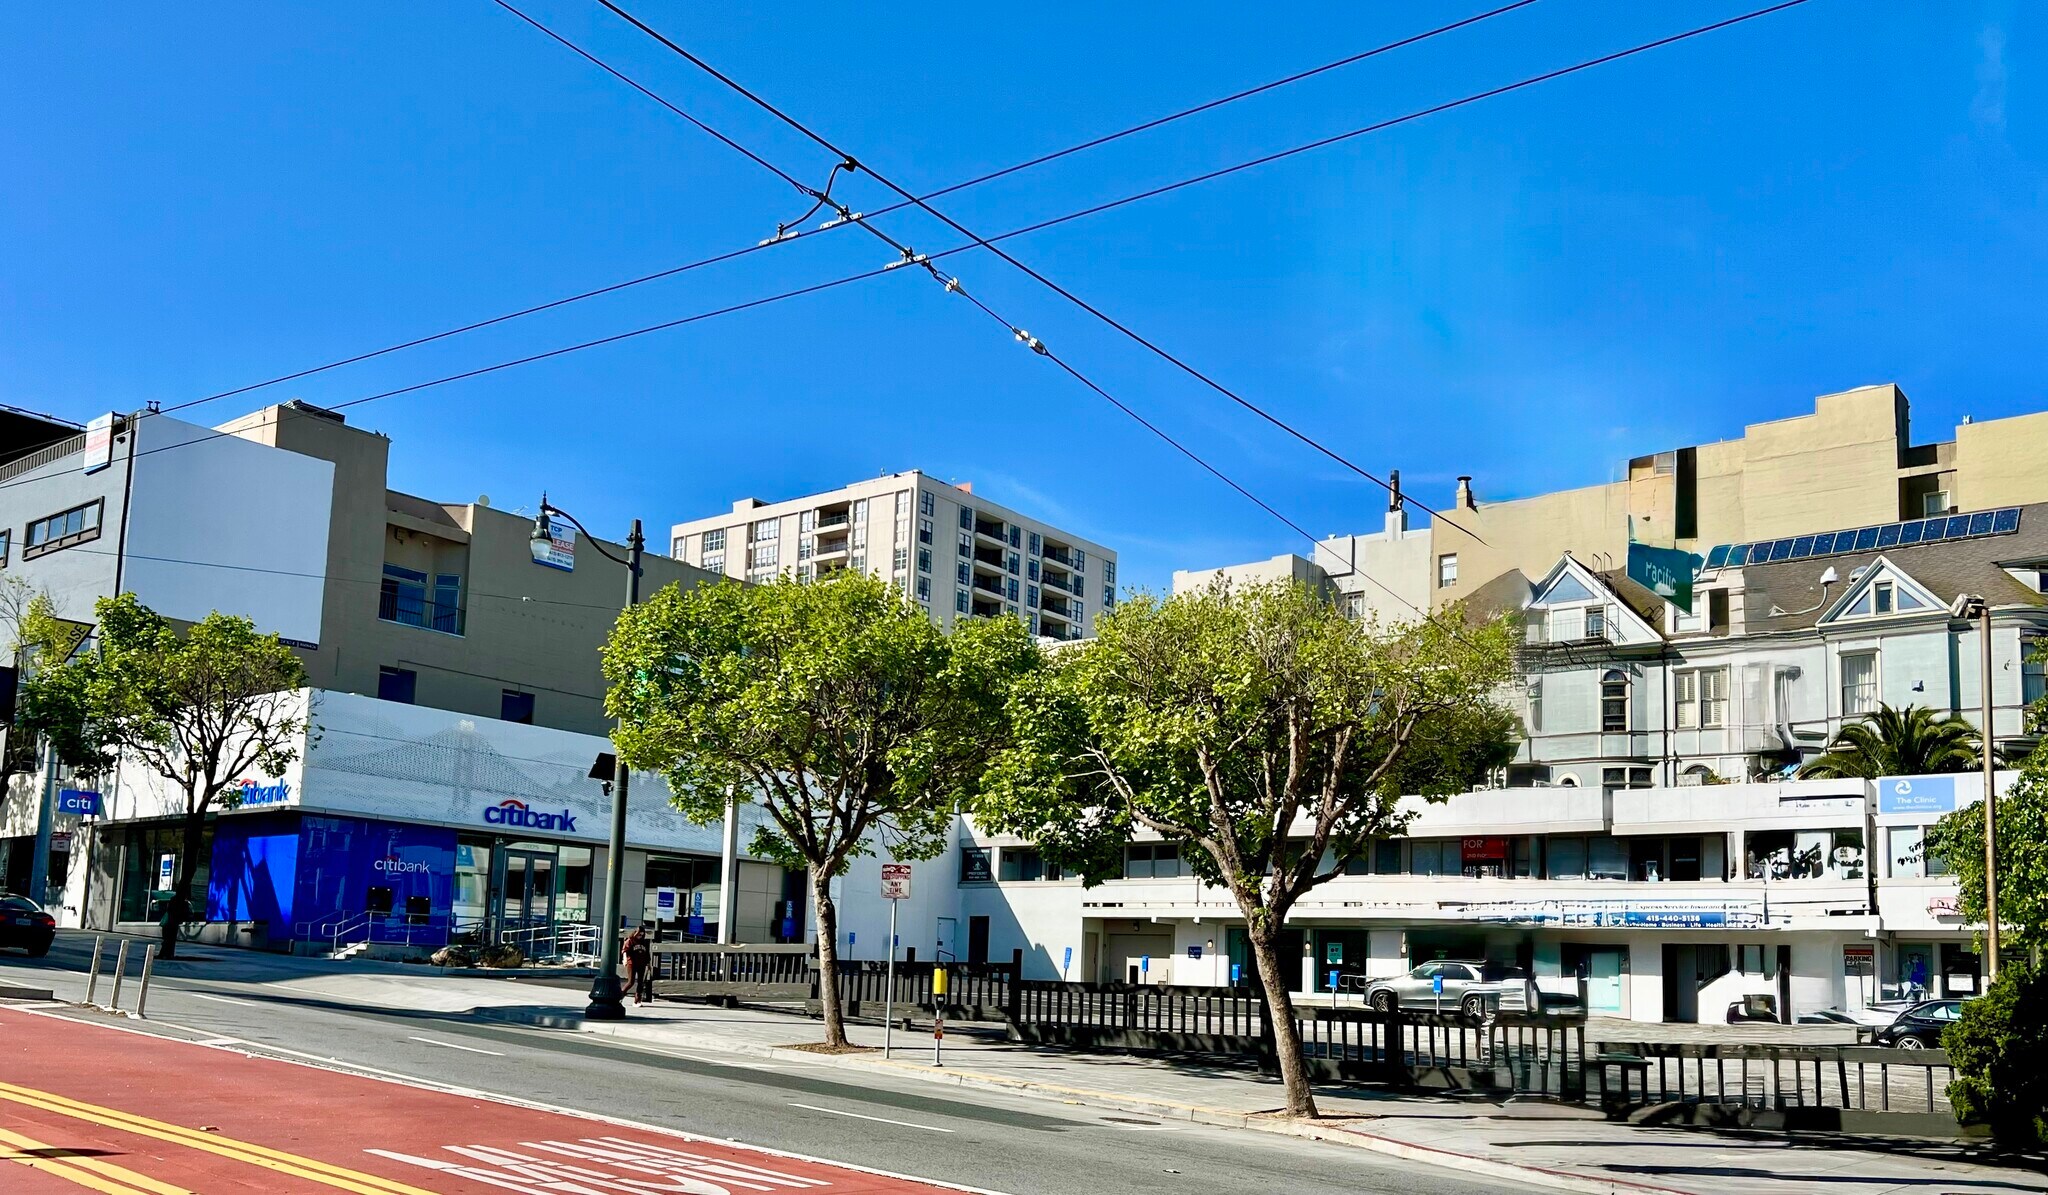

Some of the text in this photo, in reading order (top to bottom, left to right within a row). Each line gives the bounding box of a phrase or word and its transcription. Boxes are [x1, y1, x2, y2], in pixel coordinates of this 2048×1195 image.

[550, 525, 563, 533] TCP
[552, 538, 575, 551] LEASE
[231, 778, 291, 807] tibank
[66, 795, 92, 810] citi
[1913, 796, 1937, 804] Clinic
[484, 799, 577, 833] citibank
[1463, 839, 1483, 849] FOR
[374, 856, 430, 874] citibank
